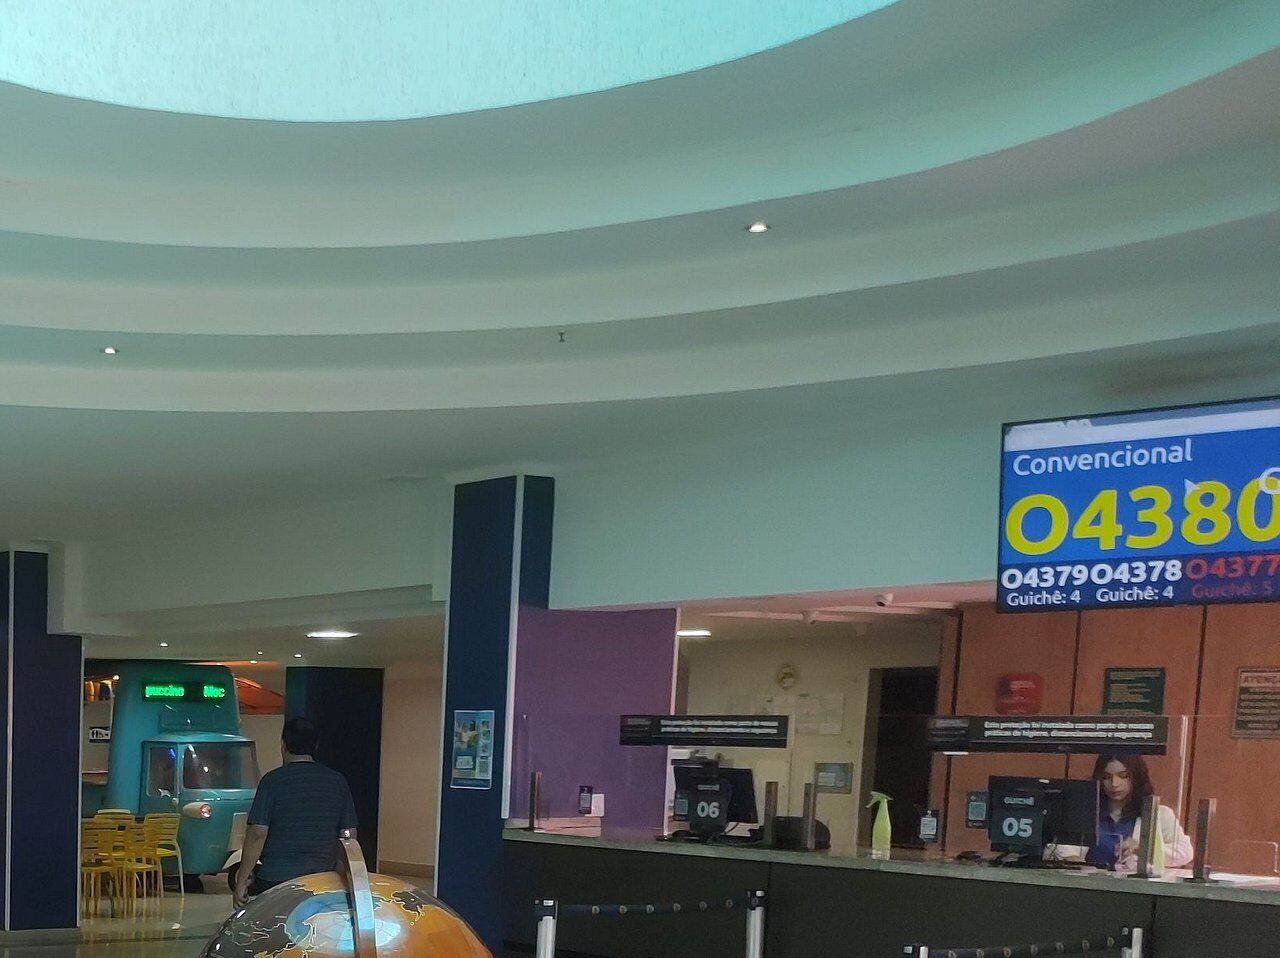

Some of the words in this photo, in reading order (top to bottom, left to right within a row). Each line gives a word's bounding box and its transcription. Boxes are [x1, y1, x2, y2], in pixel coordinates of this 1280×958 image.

[1013, 438, 1193, 476] Convencional
[1006, 590, 1067, 606] Guichê:
[1070, 589, 1081, 603] 4
[1095, 586, 1159, 602] Guichê:
[1162, 585, 1174, 599] 4
[697, 801, 720, 818] 06
[1002, 817, 1033, 838] 05
